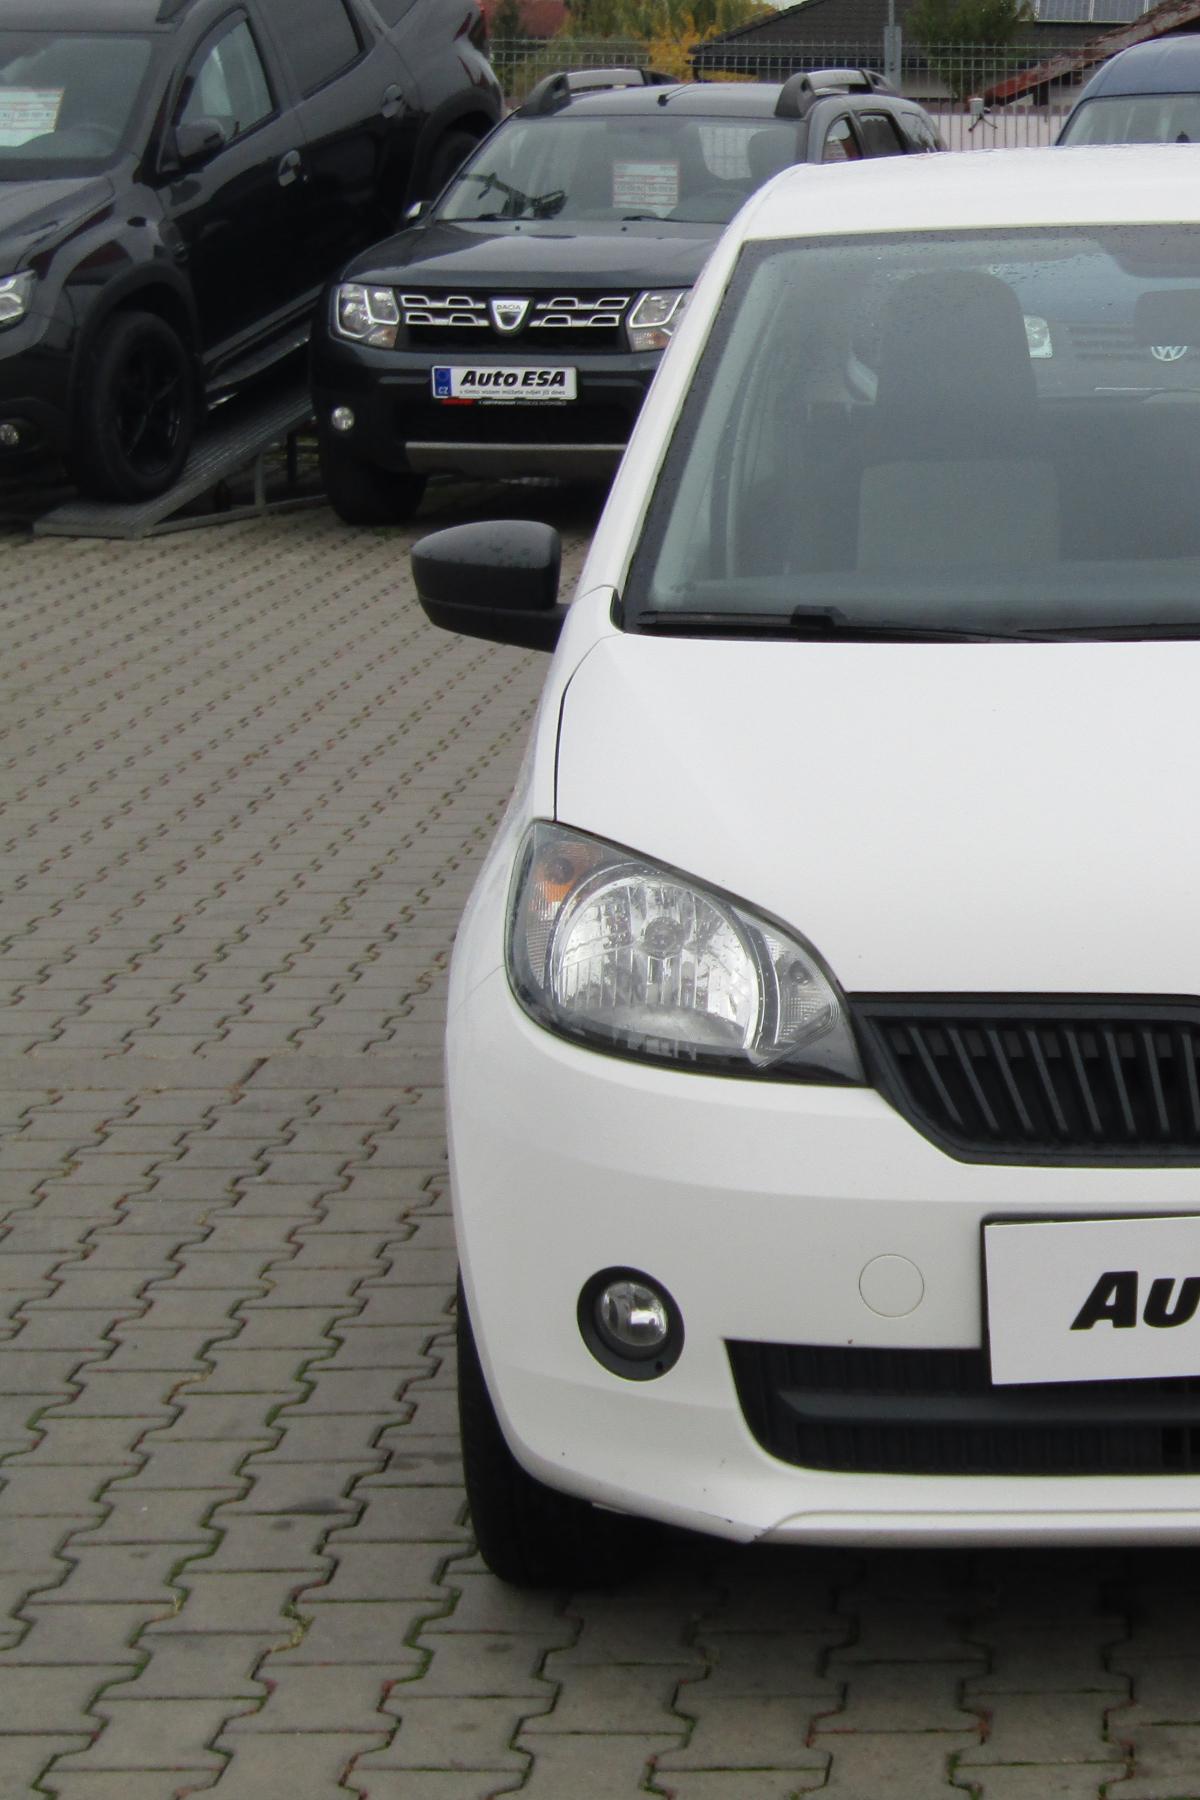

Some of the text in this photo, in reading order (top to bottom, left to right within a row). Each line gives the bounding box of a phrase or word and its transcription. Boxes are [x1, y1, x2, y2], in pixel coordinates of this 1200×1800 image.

[460, 370, 566, 387] Auto ESA
[438, 386, 449, 395] CZ
